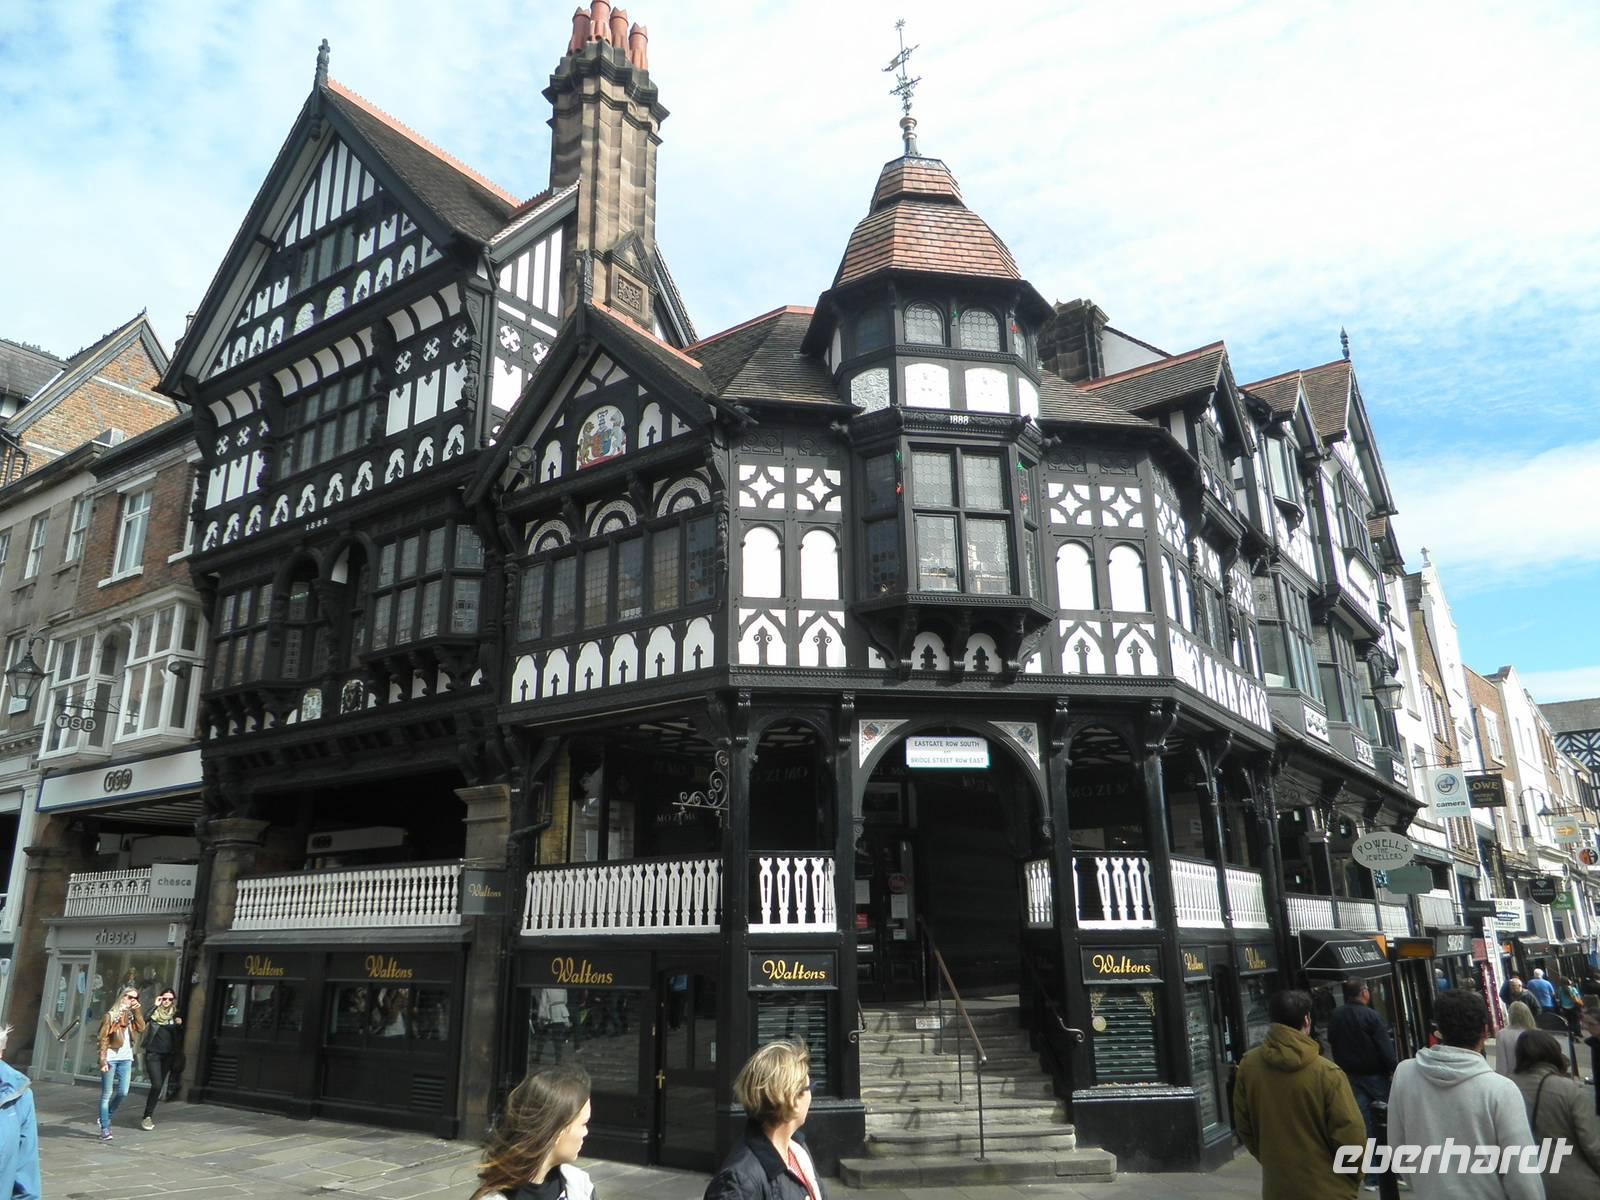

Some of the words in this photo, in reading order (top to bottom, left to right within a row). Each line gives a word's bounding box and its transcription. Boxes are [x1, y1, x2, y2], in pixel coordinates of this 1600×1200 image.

[949, 415, 969, 425] 1888
[58, 716, 95, 731] TSB
[105, 769, 132, 792] TSB
[1436, 800, 1466, 808] camera
[1356, 838, 1409, 854] POWELLS
[1365, 853, 1403, 861] JEWELLERS
[157, 877, 192, 887] chesca
[95, 928, 136, 945] chesca
[244, 955, 285, 977] Waltons
[365, 954, 414, 979] Waltons
[762, 959, 826, 980] Waltons
[1092, 954, 1152, 974] Waltons
[1183, 952, 1204, 971] Waltons
[551, 957, 614, 985] Waltons
